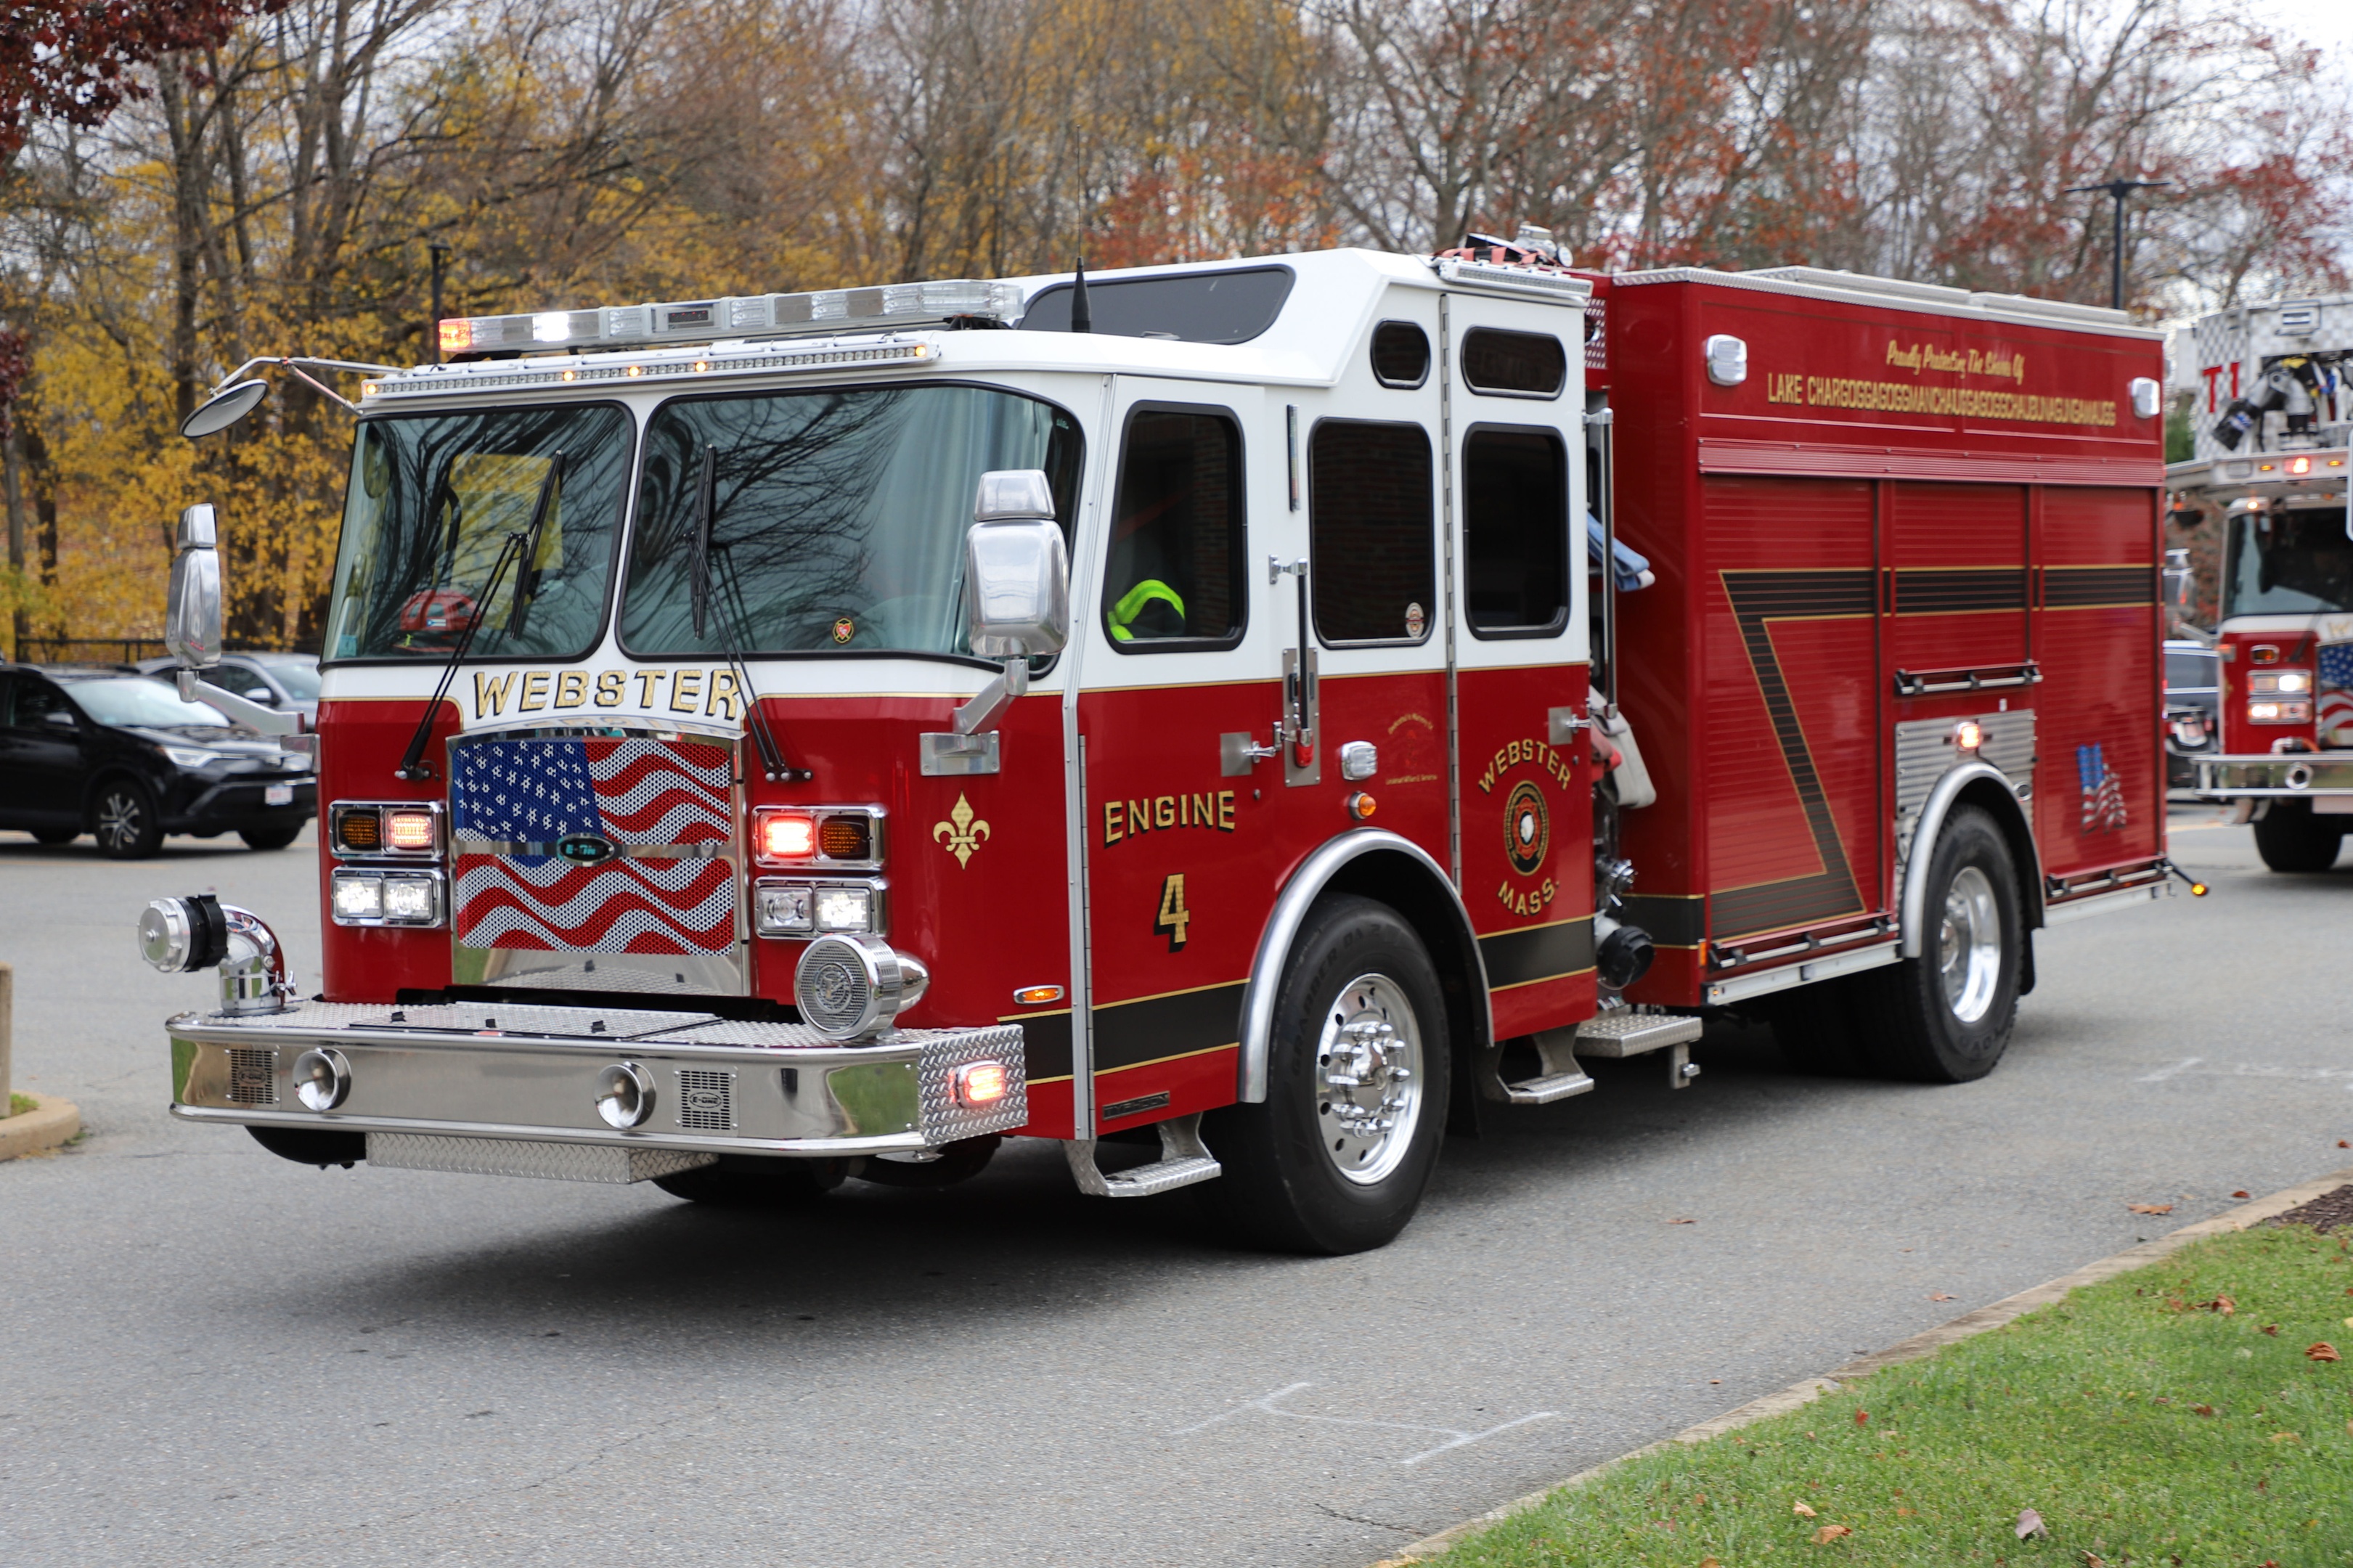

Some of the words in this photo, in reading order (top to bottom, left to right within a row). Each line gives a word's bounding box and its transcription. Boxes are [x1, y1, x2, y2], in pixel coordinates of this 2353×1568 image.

[1768, 372, 1803, 405] LAKE
[474, 669, 742, 722] WEBSTER
[1478, 738, 1572, 793] WEBSTER
[1104, 790, 1236, 849] ENGINE
[1157, 873, 1189, 948] 4
